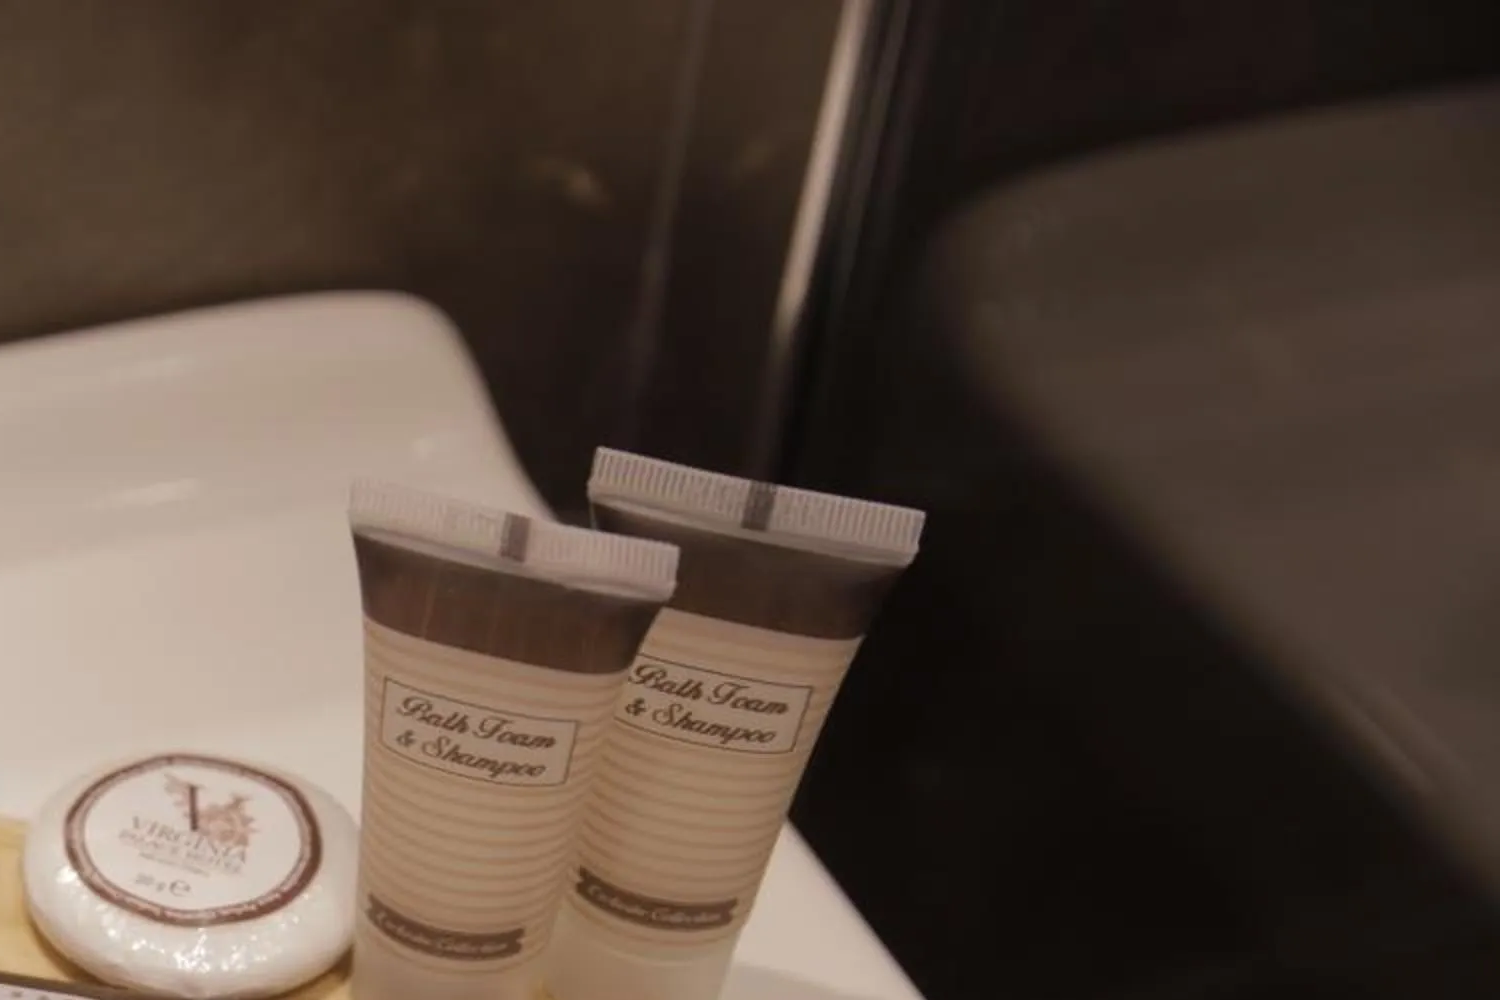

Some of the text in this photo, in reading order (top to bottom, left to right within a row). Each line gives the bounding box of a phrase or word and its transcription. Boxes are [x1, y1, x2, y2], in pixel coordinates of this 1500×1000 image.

[628, 662, 789, 715] Bath Foam
[396, 695, 556, 749] Bath Foam
[625, 699, 776, 745] & Shampoo
[396, 729, 546, 778] & Shampoo
